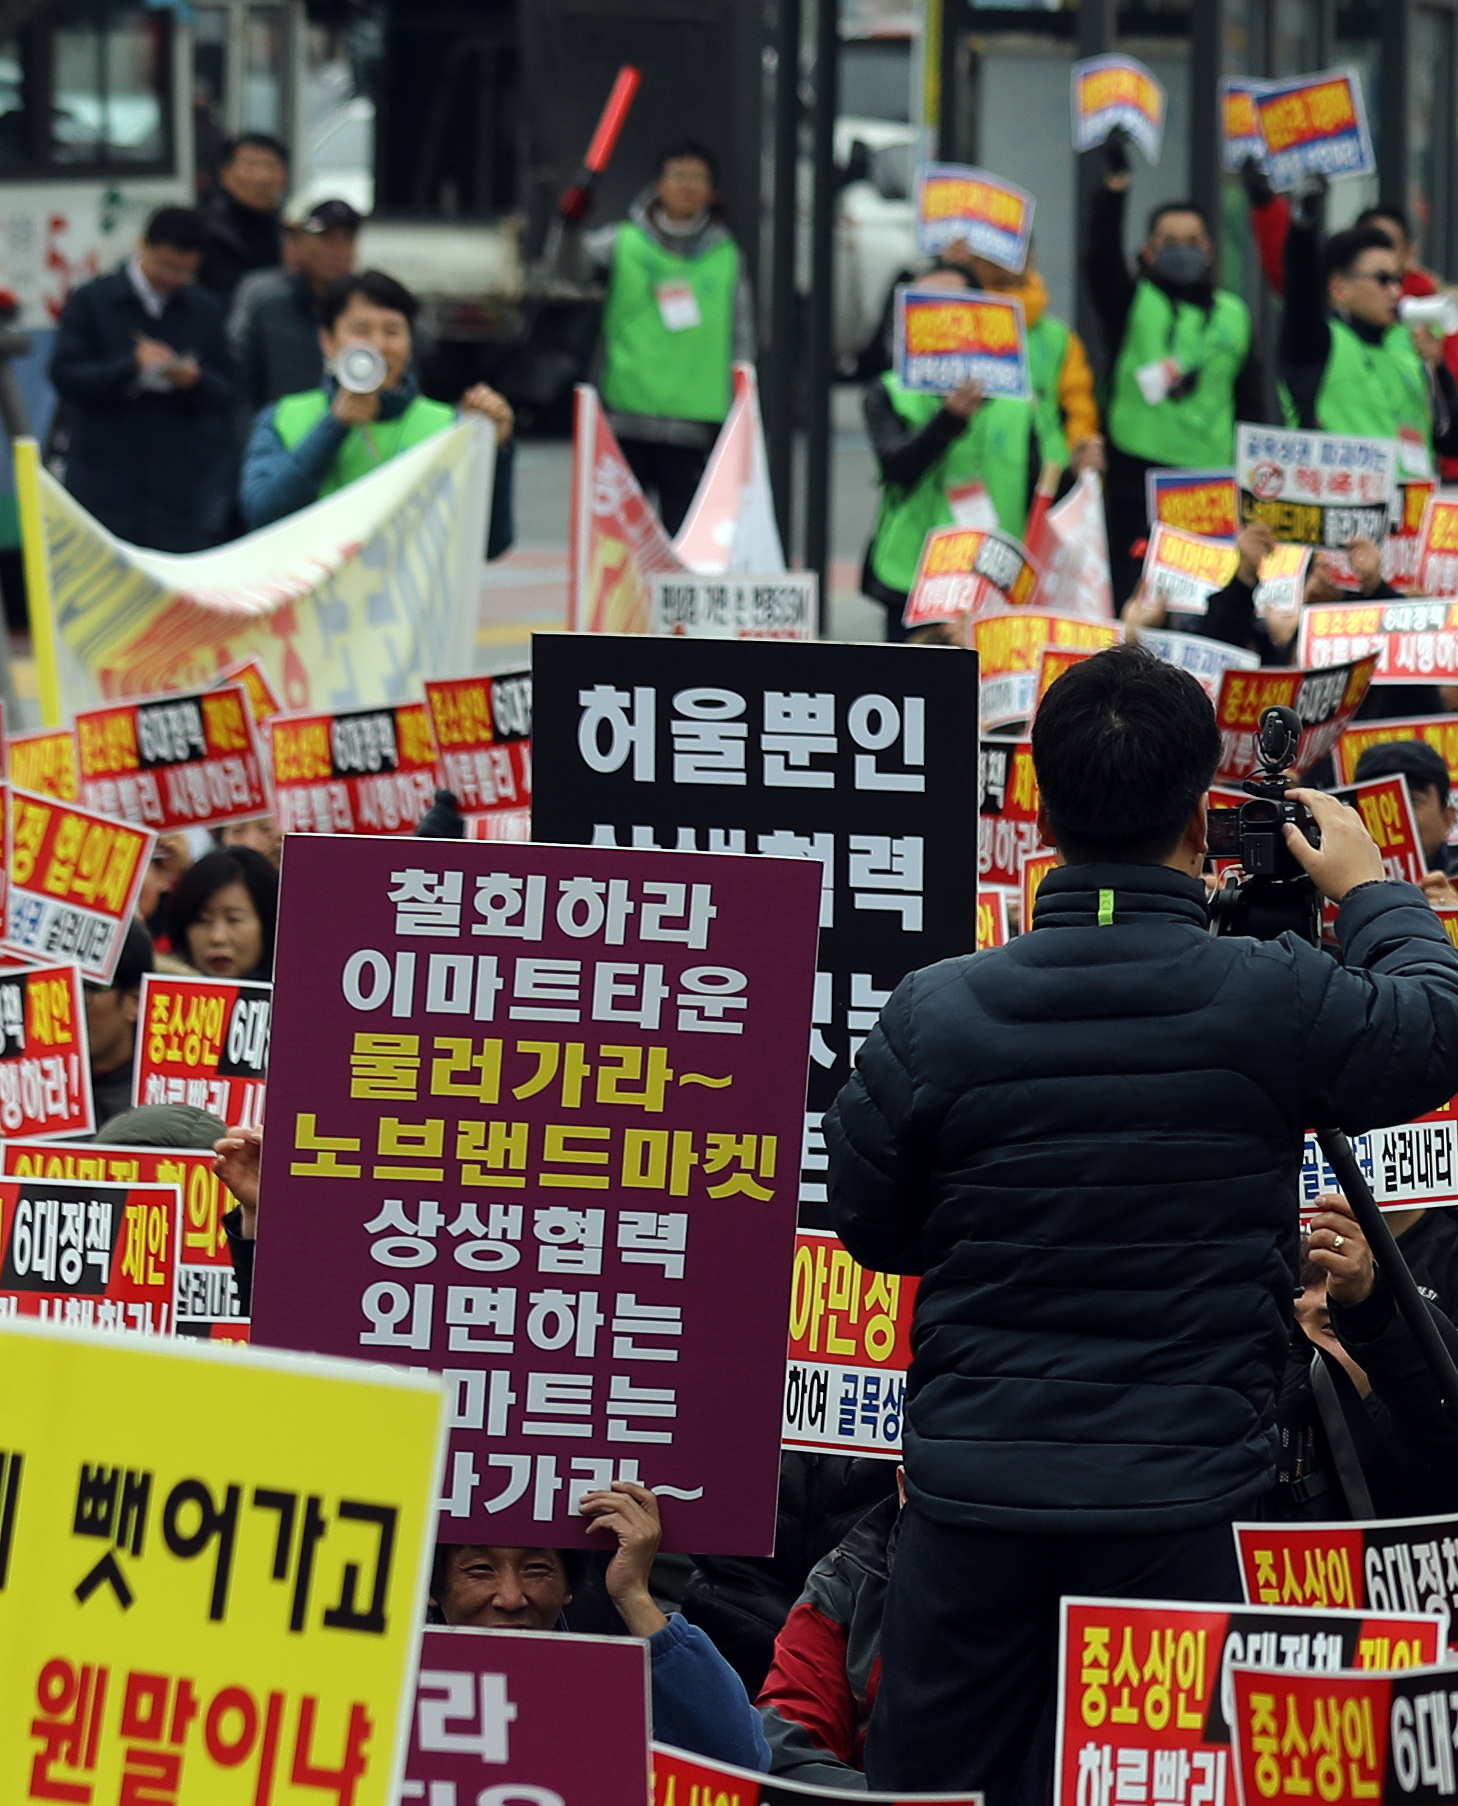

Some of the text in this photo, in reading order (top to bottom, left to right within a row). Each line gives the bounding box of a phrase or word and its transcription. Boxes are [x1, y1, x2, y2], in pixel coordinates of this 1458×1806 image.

[578, 684, 927, 791] 허울뿐인
[385, 868, 719, 950] 철회하라
[148, 996, 229, 1063] 중소상인
[341, 949, 751, 1035] 이마트타운
[349, 1032, 733, 1112] 물러가라~
[290, 1114, 778, 1200] 노브랜드마켓
[1382, 1130, 1454, 1188] 살려내라
[362, 1200, 690, 1279] 상생협력
[360, 1281, 683, 1362] 외면하는
[74, 1459, 401, 1635] 뺏어가고
[1080, 1625, 1208, 1730] 중소상인
[1249, 1688, 1381, 1804] 중소상인
